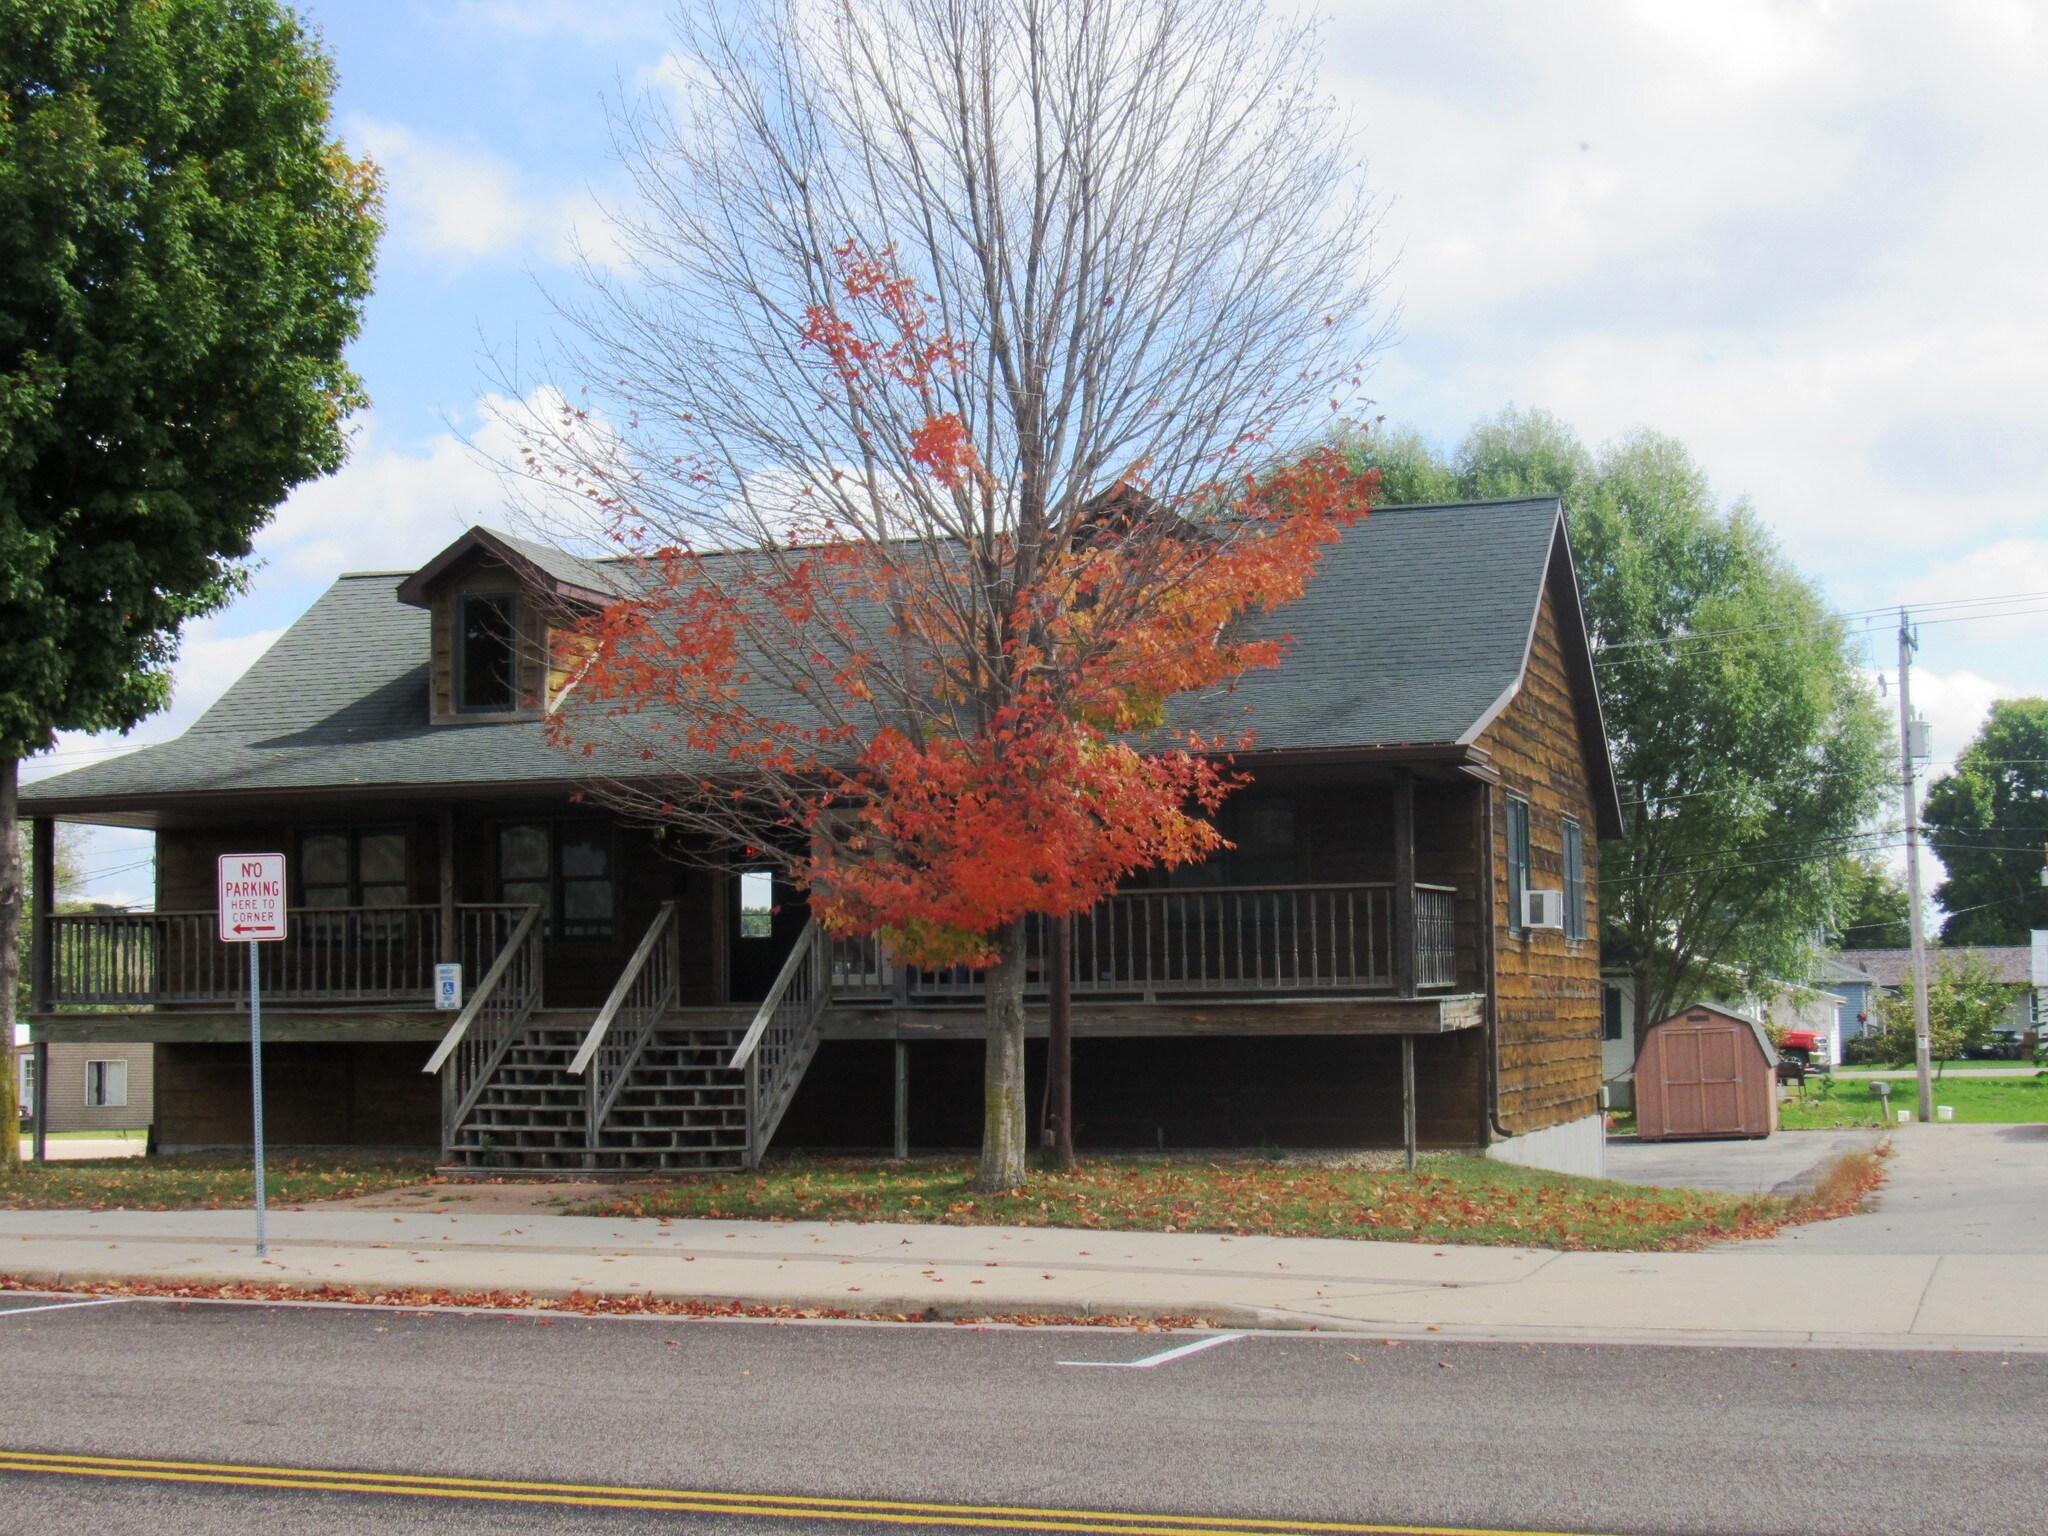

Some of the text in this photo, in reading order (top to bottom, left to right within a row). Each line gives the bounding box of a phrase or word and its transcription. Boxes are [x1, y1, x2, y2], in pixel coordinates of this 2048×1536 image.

[241, 862, 262, 878] NO
[226, 881, 279, 897] PARKING
[231, 899, 275, 910] HERE TO
[232, 912, 274, 923] CORNER
